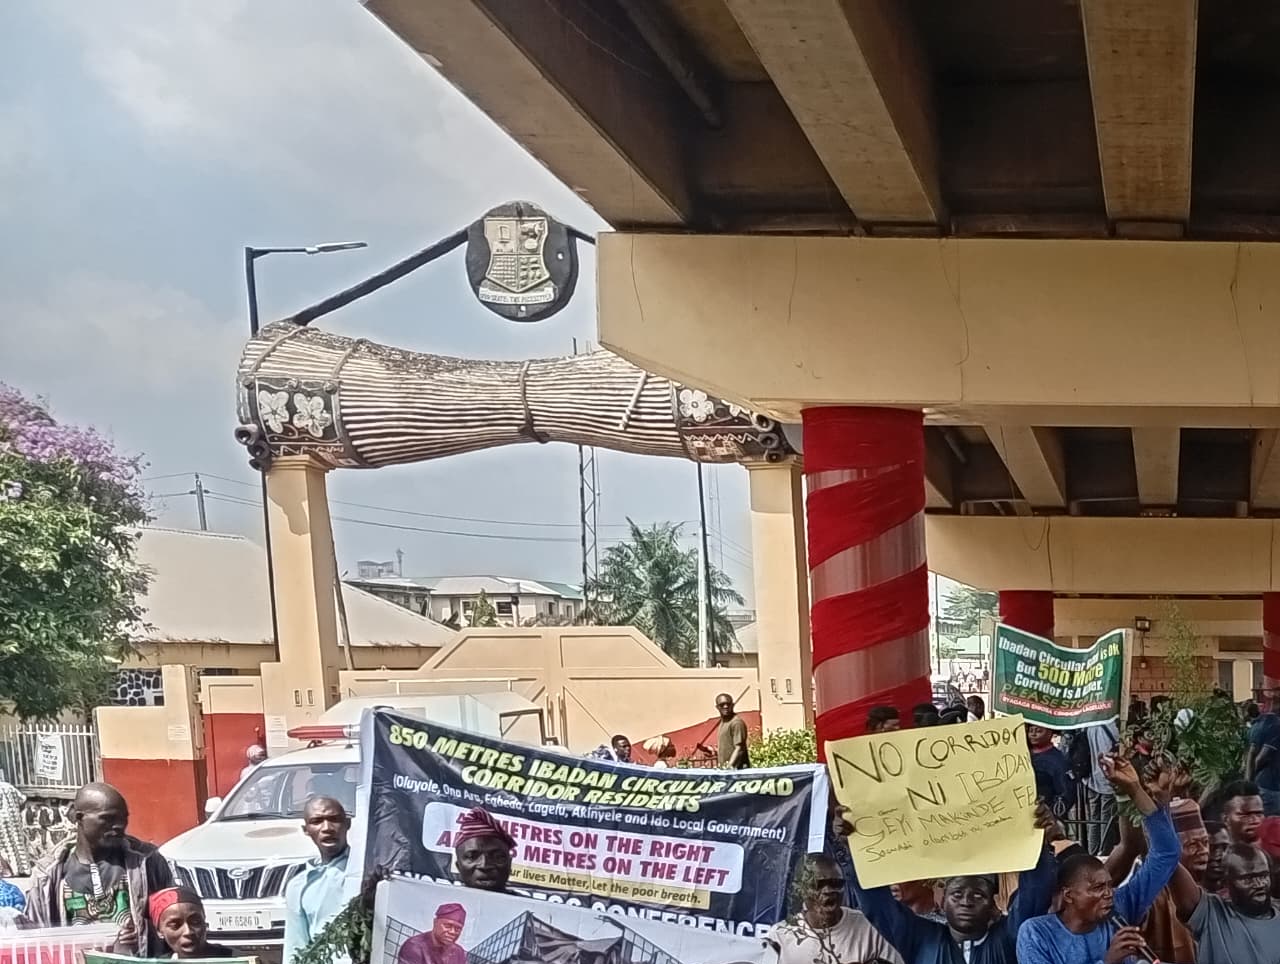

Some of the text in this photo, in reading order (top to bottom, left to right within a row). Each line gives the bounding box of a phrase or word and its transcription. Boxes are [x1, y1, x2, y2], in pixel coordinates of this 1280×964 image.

[998, 636, 1037, 660] Ibadan
[1014, 674, 1061, 698] Corridor
[1016, 660, 1036, 677] But
[1038, 663, 1070, 686] 500
[1002, 684, 1059, 708] PLEASE
[1061, 695, 1085, 709] STO
[389, 725, 795, 796] 850 METRES IBADAN CIRCULAR ROAD
[832, 741, 903, 789] NO
[461, 765, 701, 813] CORRIDOR RESIDENTS
[393, 774, 442, 795] (Oluyole,
[624, 812, 648, 826] and
[673, 817, 705, 832] Local
[707, 820, 787, 843] Government)
[569, 830, 599, 850] ON
[605, 835, 644, 856] THE
[649, 840, 716, 864] RIGHT
[523, 847, 597, 871] METRES
[602, 856, 632, 876] ON
[640, 861, 680, 880] THE
[682, 867, 730, 887] LEFT
[523, 869, 546, 882] lives
[610, 882, 629, 895] the
[631, 886, 660, 900] poor
[661, 890, 702, 905] breath.
